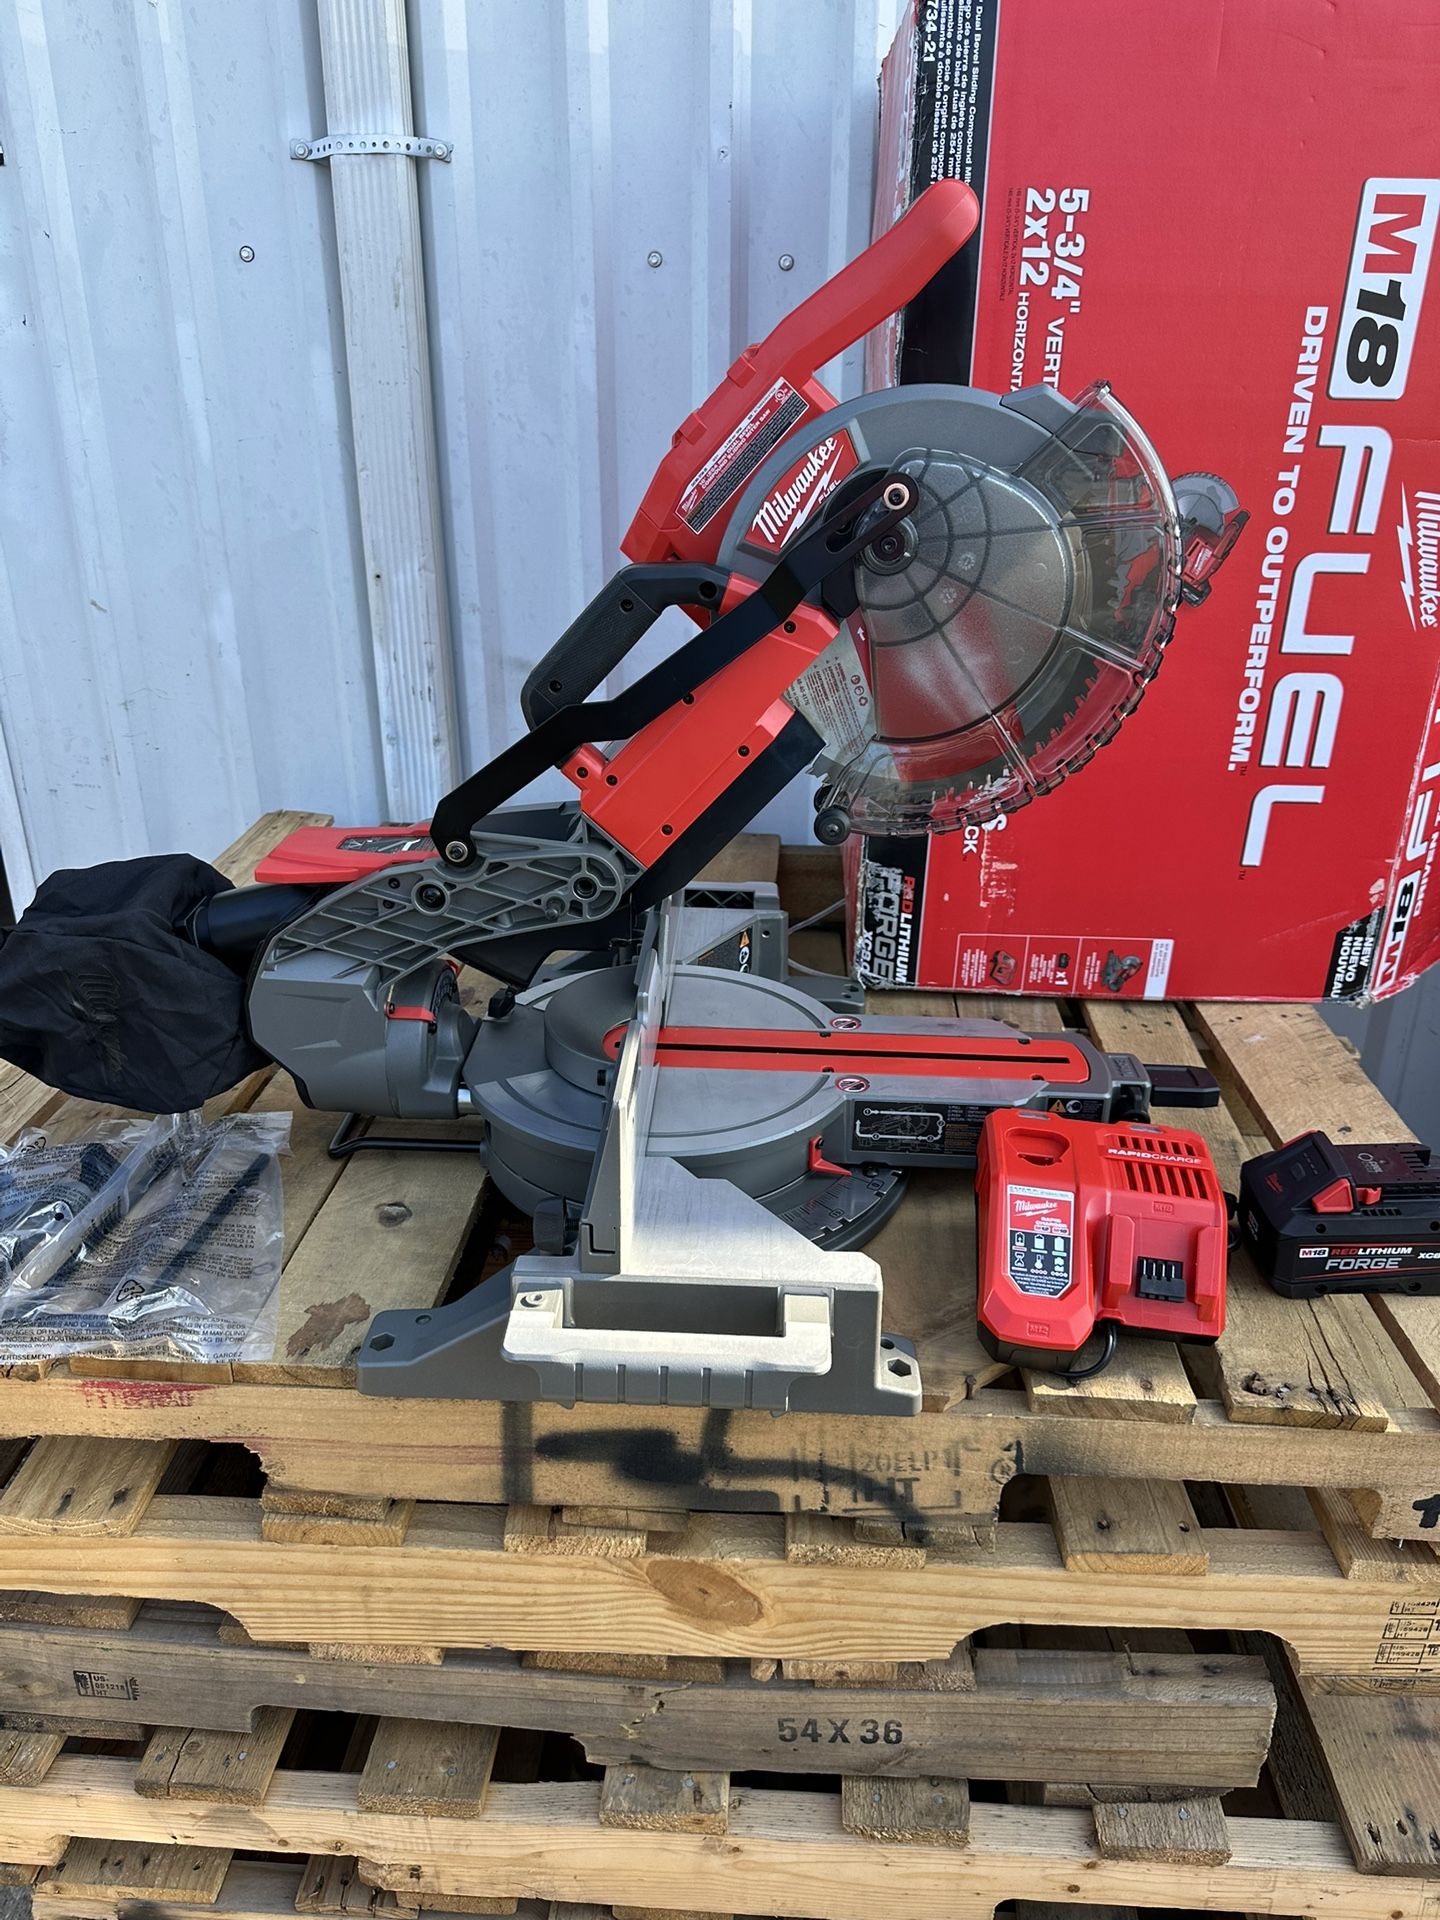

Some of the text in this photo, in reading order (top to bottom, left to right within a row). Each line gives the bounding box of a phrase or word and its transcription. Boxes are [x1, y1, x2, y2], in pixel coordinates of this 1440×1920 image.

[964, 22, 971, 36] de
[975, 6, 983, 30] Dual
[946, 42, 953, 55] de
[955, 44, 963, 57] de
[962, 39, 970, 71] sierra
[973, 34, 981, 64] Bevel
[936, 62, 944, 98] double
[961, 76, 968, 88] de
[968, 67, 979, 103] Sliding
[940, 95, 949, 128] onglet
[952, 90, 960, 112] dual
[958, 92, 967, 128] inglete
[933, 102, 942, 137] biseau
[951, 116, 958, 129] de
[932, 140, 940, 153] de
[949, 132, 957, 154] 254
[965, 107, 976, 164] Compound
[930, 157, 938, 178] 254
[948, 157, 955, 177] mm
[1020, 187, 1057, 285] 2x12
[1042, 188, 1090, 391] 5-3/4" VERT
[1282, 306, 1329, 455] DRIVEN
[700, 458, 730, 490] COMPOUND
[726, 437, 748, 460] SLIDING
[758, 408, 772, 422] SAW
[752, 436, 838, 544] Milwaukee
[818, 479, 842, 504] FUEL
[1270, 469, 1301, 516] TO
[1241, 193, 1427, 868] M18 FUEL
[1414, 491, 1440, 628] Milwaukee
[1413, 833, 1439, 917] DRIVEN
[1382, 881, 1414, 983] M18
[1345, 937, 1363, 982] NUEVO
[1359, 937, 1374, 966] NEW
[1055, 971, 1069, 985] x1
[1331, 936, 1353, 998] NOUVEAU
[1108, 1148, 1202, 1164] RAPIDCHARGE
[1014, 1200, 1057, 1213] Milwaukee
[1300, 1248, 1327, 1257] M18
[1331, 1247, 1413, 1255] REDLITHIUM
[1325, 1258, 1402, 1270] FORGE
[777, 1717, 904, 1745] 54 X 36
